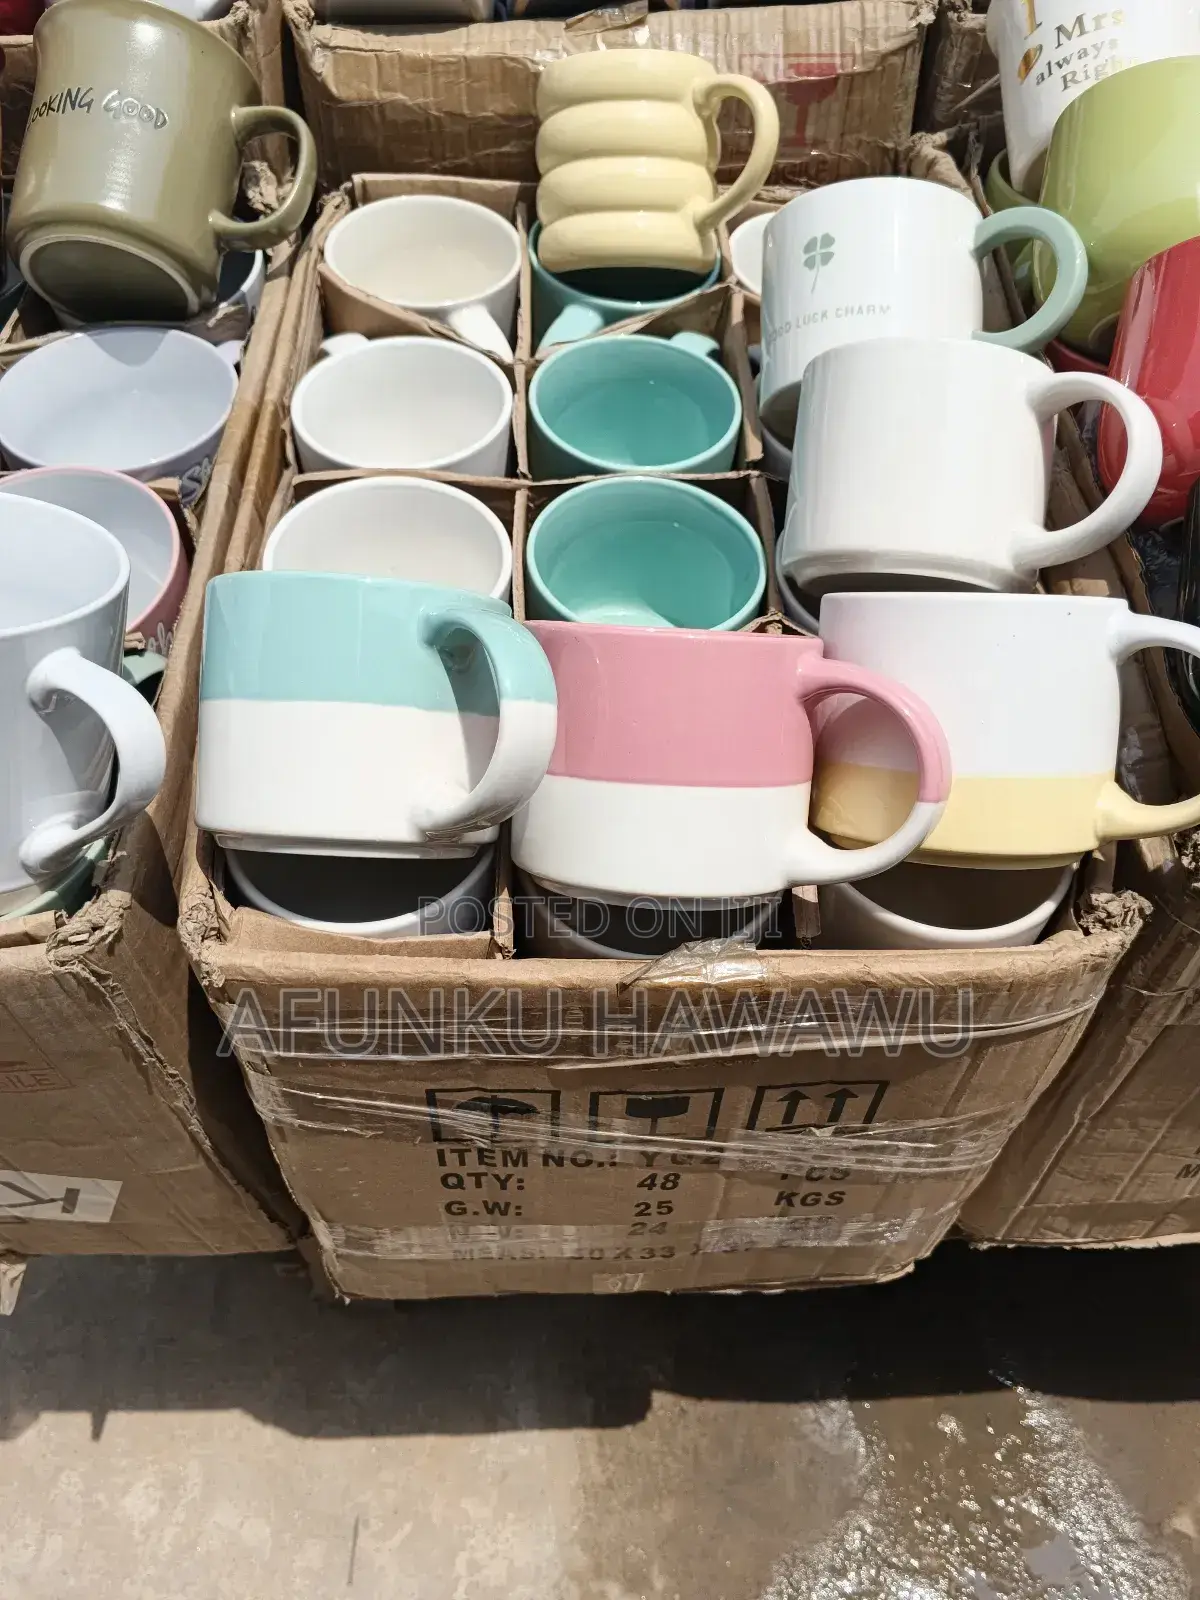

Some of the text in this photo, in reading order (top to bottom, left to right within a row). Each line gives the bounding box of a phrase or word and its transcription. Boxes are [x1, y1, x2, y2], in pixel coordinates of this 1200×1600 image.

[1053, 9, 1126, 50] Mrs
[1035, 38, 1119, 86] always
[102, 88, 169, 130] GOOD
[795, 310, 828, 330] LUCK
[835, 305, 892, 319] CHARM
[436, 1148, 529, 1168] ITEM
[440, 1172, 525, 1190] QTY:
[636, 1172, 681, 1191] 48
[444, 1190, 846, 1217] G.W: 25 KGS
[627, 1221, 668, 1236] 24
